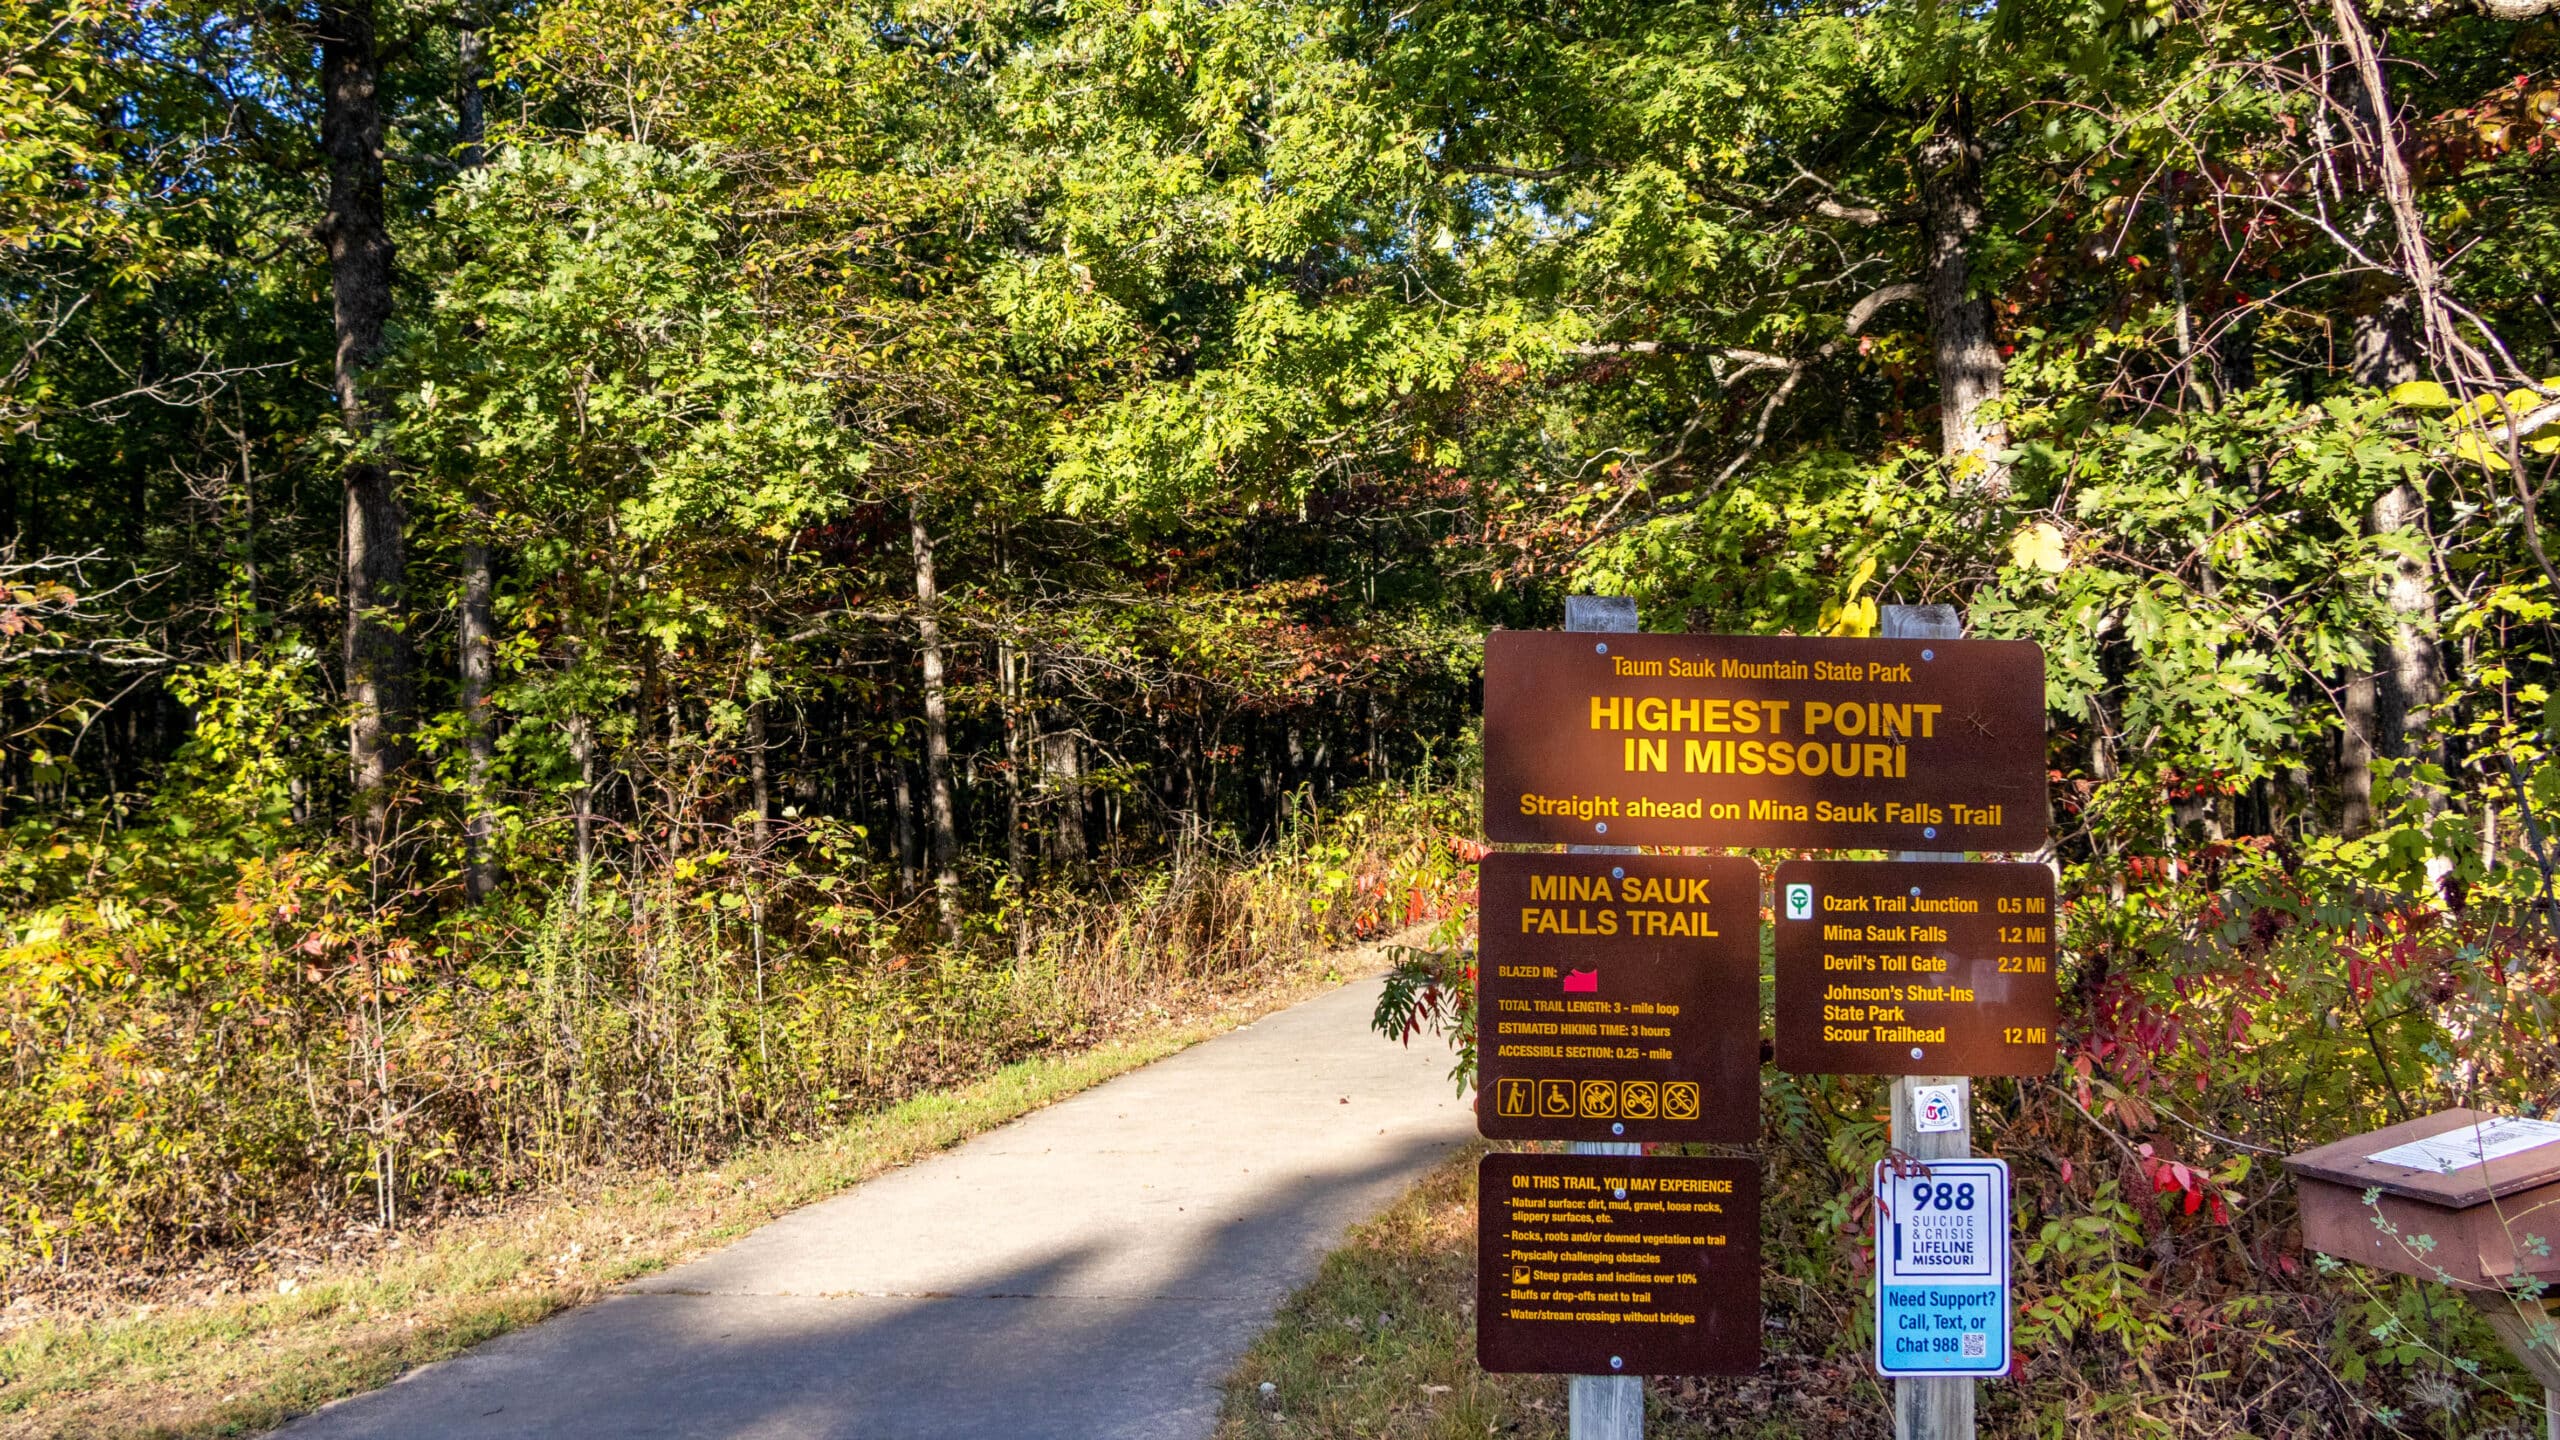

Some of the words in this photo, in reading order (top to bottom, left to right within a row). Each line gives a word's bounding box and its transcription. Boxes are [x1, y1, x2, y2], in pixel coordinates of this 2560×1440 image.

[1612, 656, 1663, 678] Taum
[1668, 657, 1716, 679] Sauk
[1721, 658, 1809, 681] Mountain
[1814, 661, 1863, 682] State
[1868, 662, 1912, 683] Park
[1590, 696, 1790, 735] HIGHEST
[1804, 700, 1942, 739] POINT
[1624, 738, 1667, 772] IN
[1685, 740, 1907, 778] MISSOURI
[1519, 793, 1620, 821] Straight
[1626, 796, 1703, 819] ahead
[1709, 800, 1741, 820] on
[1748, 799, 1808, 822] Mina
[1815, 800, 1877, 824] Sauk
[1885, 802, 1943, 825] Falls
[1950, 804, 2002, 826] Trail
[1530, 875, 1613, 901] MINA
[1621, 877, 1711, 904] SAUK
[1823, 895, 1869, 912] Ozark
[1872, 895, 1906, 912] Trail
[1910, 896, 1978, 913] Junction
[1997, 897, 2023, 914] 0.5
[2026, 897, 2045, 914] Mi
[1521, 908, 1618, 935] FALLS
[1626, 910, 1719, 937] TRAIL
[1823, 925, 1862, 941] Mina
[1866, 925, 1906, 942] Sauk
[1910, 926, 1947, 942] Falls
[1998, 927, 2023, 943] 1.2
[2026, 927, 2046, 943] Mi
[1499, 965, 1540, 978] BLAZED
[1543, 966, 1558, 978] IN:
[1879, 955, 1907, 971] Toll
[1911, 955, 1947, 972] Gate
[1998, 957, 2023, 973] 2.2
[2026, 957, 2046, 973] Mi
[1907, 985, 1974, 1002] Shut-Ins
[1498, 999, 1531, 1012] TOTAL
[1534, 1000, 1565, 1013] TRAIL
[1567, 1001, 1612, 1013] LENGTH:
[1613, 1002, 1621, 1013] 3
[1631, 1002, 1654, 1014] mile
[1656, 1002, 1680, 1016] loop
[1823, 1005, 1865, 1021] State
[1868, 1006, 1905, 1022] Park
[1498, 1022, 1558, 1035] ESTIMATED
[1560, 1024, 1597, 1036] HIKING
[1600, 1024, 1629, 1036] TIME:
[1631, 1025, 1638, 1037] 3
[1640, 1025, 1671, 1037] hours
[1823, 1025, 1869, 1042] Scour
[1873, 1026, 1946, 1043] Trailhead
[2003, 1027, 2023, 1044] 12
[2027, 1027, 2046, 1044] Mi
[1498, 1045, 1564, 1058] ACCESSIBLE
[1566, 1046, 1614, 1059] SECTION:
[1616, 1047, 1639, 1059] 0.25
[1649, 1047, 1673, 1060] mile
[1512, 1175, 1530, 1188] ON
[1532, 1176, 1560, 1189] THIS
[1563, 1176, 1601, 1192] TRAIL,
[1603, 1177, 1628, 1190] YOU
[1630, 1178, 1657, 1191] MAY
[1659, 1179, 1733, 1193] EXPERIENCE
[1912, 1182, 1975, 1211] 988
[1512, 1198, 1546, 1208] Natural
[1548, 1198, 1586, 1209] surface:
[1588, 1199, 1607, 1210] dirt,
[1608, 1200, 1632, 1211] mud,
[1634, 1200, 1665, 1213] gravel,
[1666, 1201, 1692, 1212] loose
[1693, 1202, 1723, 1214] rocks,
[1512, 1211, 1549, 1224] slippery
[1552, 1212, 1594, 1224] surfaces,
[1596, 1213, 1613, 1223] etc.
[1912, 1215, 1974, 1227] SUICIDE
[1511, 1231, 1543, 1242] Rocks,
[1544, 1232, 1569, 1242] roots
[1571, 1232, 1602, 1243] and/or
[1603, 1233, 1641, 1244] downed
[1642, 1233, 1691, 1246] vegetation
[1693, 1236, 1705, 1245] on
[1706, 1235, 1726, 1245] trail
[1912, 1228, 1920, 1240] &
[1925, 1228, 1974, 1240] CRISIS
[1913, 1241, 1974, 1254] LIFELINE
[1511, 1250, 1558, 1263] Physically
[1560, 1251, 1614, 1264] challenging
[1616, 1252, 1660, 1263] obstacles
[1912, 1255, 1974, 1265] MISSOURI
[1533, 1270, 1560, 1282] Steep
[1562, 1271, 1594, 1283] grades
[1596, 1272, 1613, 1282] and
[1615, 1272, 1652, 1283] inclines
[1653, 1274, 1674, 1284] over
[1676, 1273, 1697, 1284] 10%
[1511, 1290, 1539, 1300] Bluffs
[1540, 1292, 1550, 1300] or
[1552, 1290, 1596, 1303] drop-offs
[1598, 1292, 1619, 1302] next
[1620, 1292, 1630, 1302] to
[1632, 1292, 1651, 1303] trail
[1889, 1291, 1926, 1307] Need
[1929, 1291, 1996, 1310] Support?
[1510, 1309, 1574, 1321] Water/stream
[1576, 1311, 1621, 1323] crossings
[1623, 1312, 1658, 1323] without
[1660, 1312, 1695, 1325] bridges
[1899, 1314, 1930, 1332] Call,
[1934, 1314, 1967, 1332] Text,
[1970, 1316, 1985, 1330] or
[1896, 1337, 1929, 1353] Chat
[1932, 1337, 1959, 1353] 988
